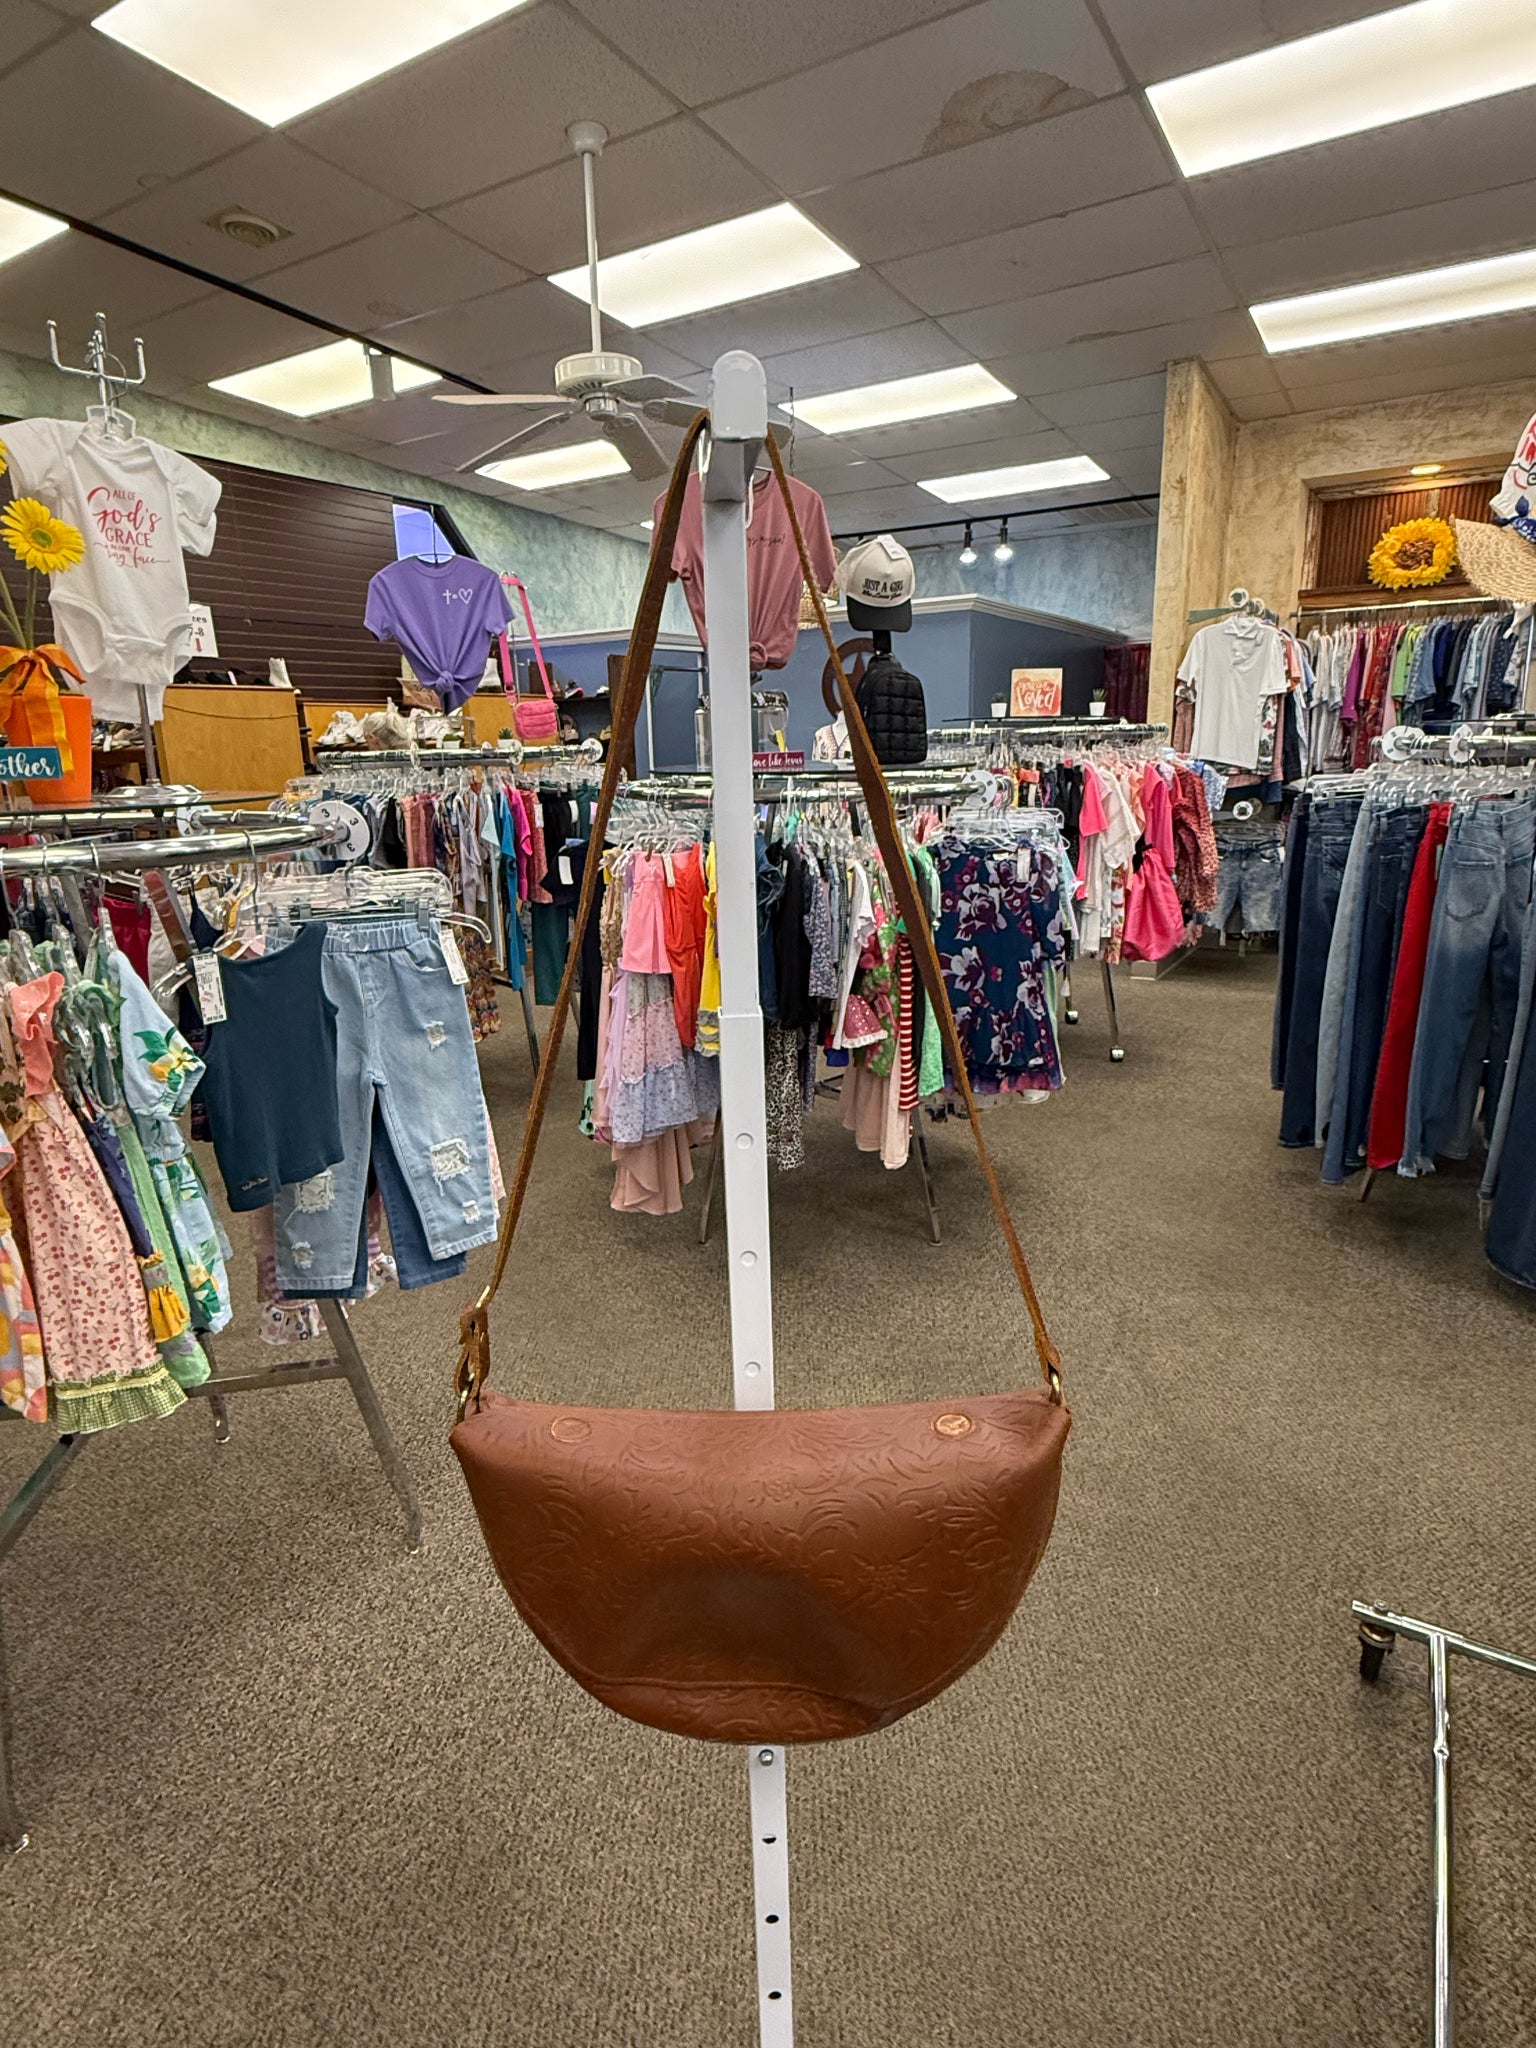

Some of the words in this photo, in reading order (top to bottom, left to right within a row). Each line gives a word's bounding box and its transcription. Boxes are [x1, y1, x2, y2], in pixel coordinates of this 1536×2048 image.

[112, 489, 126, 500] ALL
[87, 486, 162, 533] God's
[105, 527, 152, 548] GRACE
[881, 581, 887, 593] A
[0, 752, 56, 777] other
[753, 760, 767, 768] ove
[768, 752, 781, 768] like
